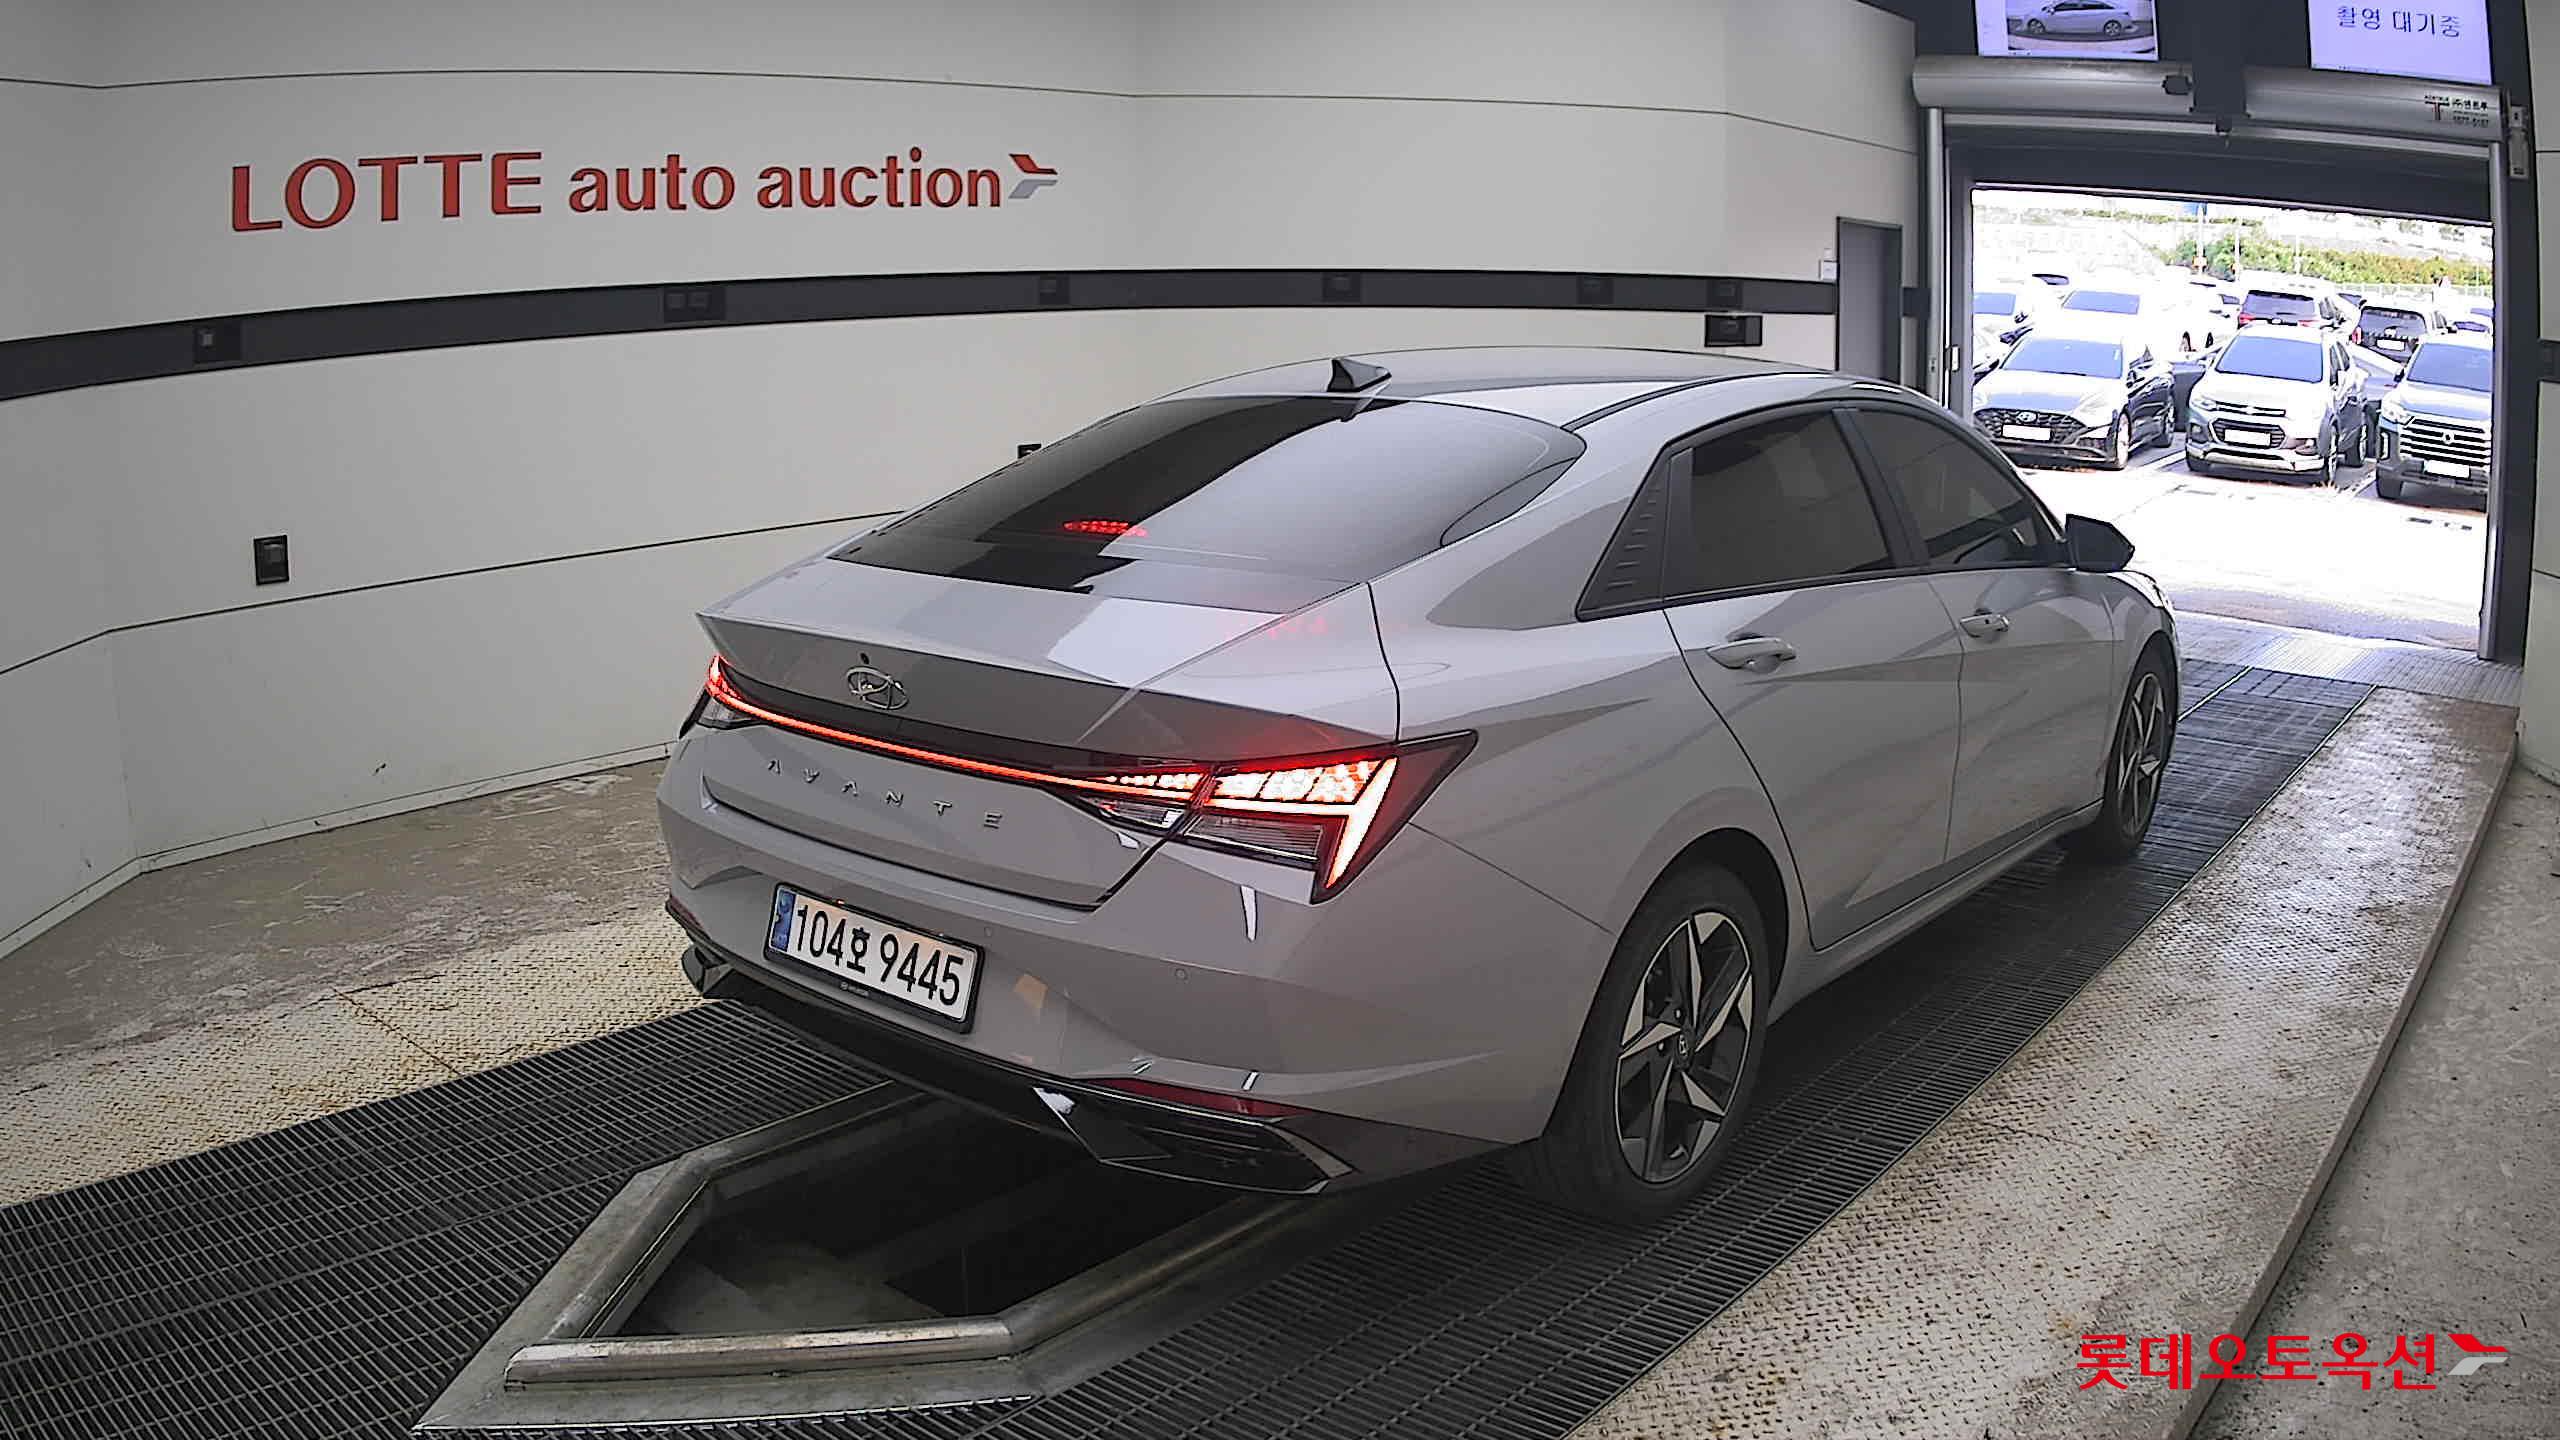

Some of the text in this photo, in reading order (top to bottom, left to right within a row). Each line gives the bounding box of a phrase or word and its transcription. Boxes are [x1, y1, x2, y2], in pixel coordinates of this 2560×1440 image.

[2337, 5, 2460, 38] 촬영 대기중
[231, 147, 1002, 233] LOTTE auto auction
[768, 759, 1002, 829] AVANTE
[797, 904, 964, 1006] 104호 9445
